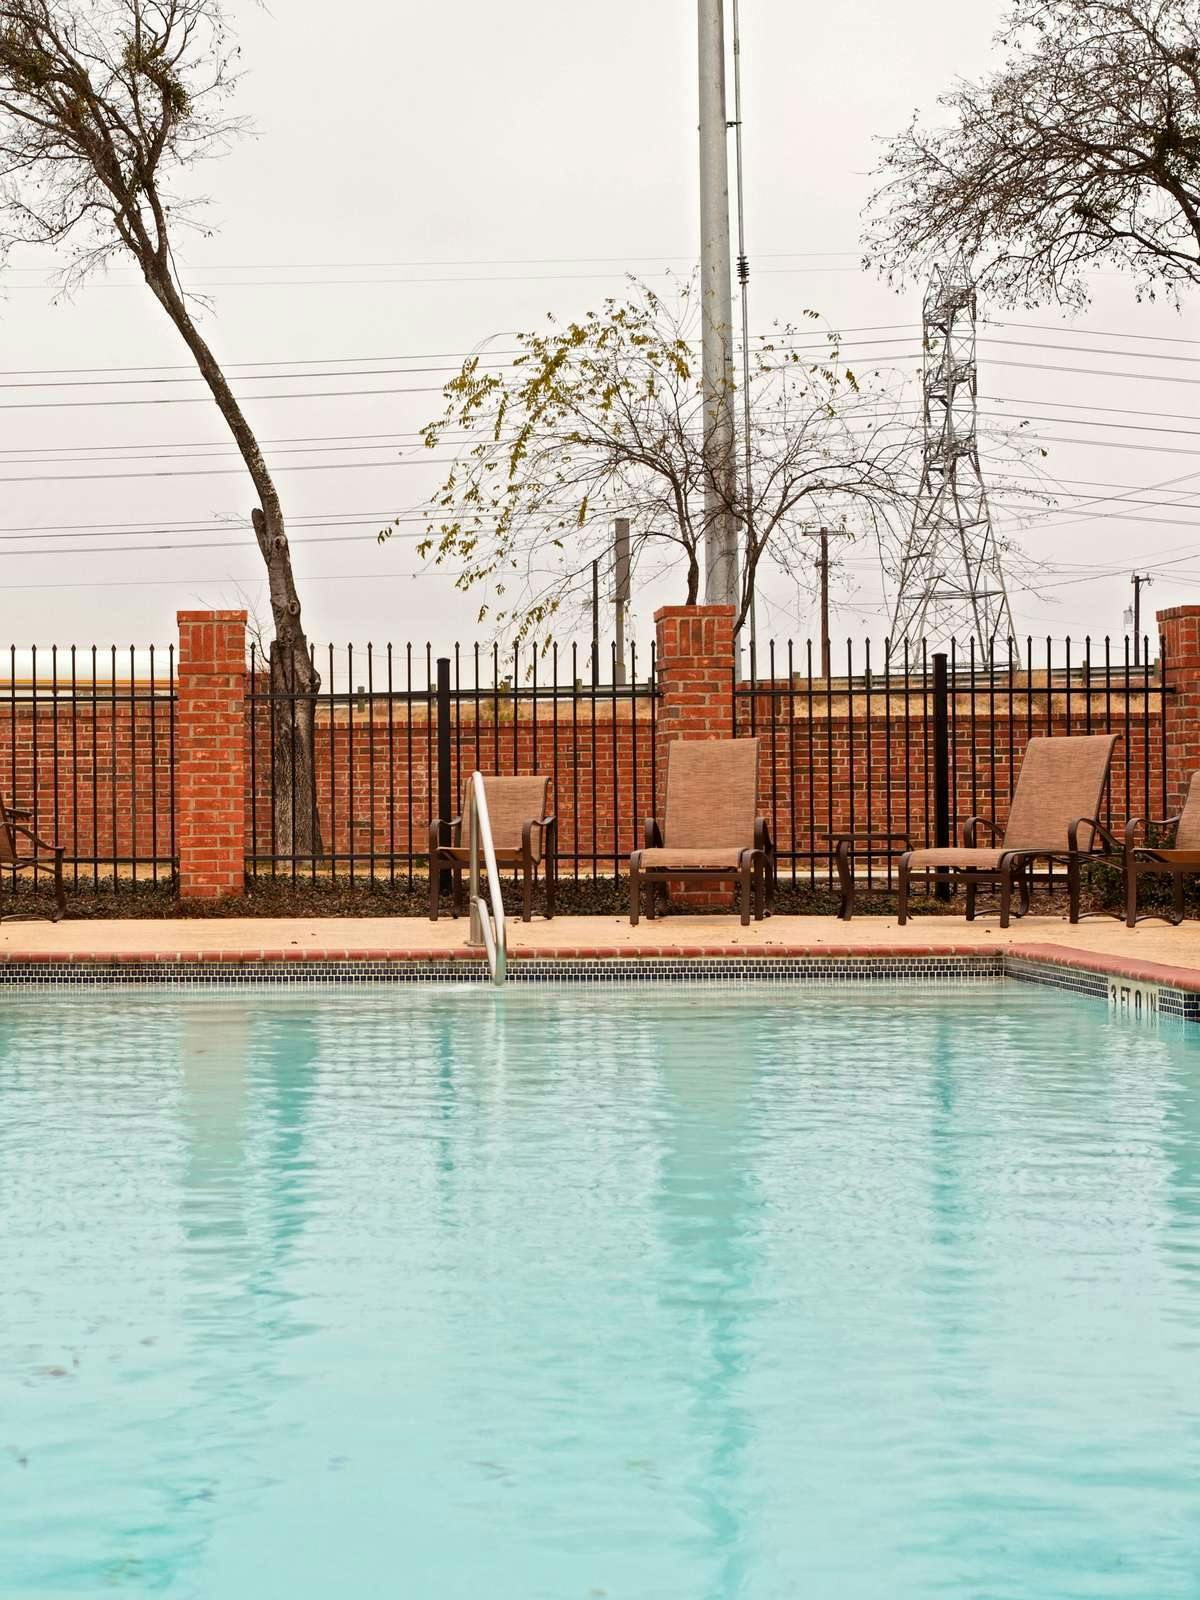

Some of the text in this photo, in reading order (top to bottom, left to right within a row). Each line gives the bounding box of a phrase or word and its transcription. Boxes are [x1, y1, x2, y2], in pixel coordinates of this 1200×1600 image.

[1111, 984, 1117, 1004] 3
[1121, 986, 1131, 1008] FT
[1146, 992, 1158, 1012] IN
